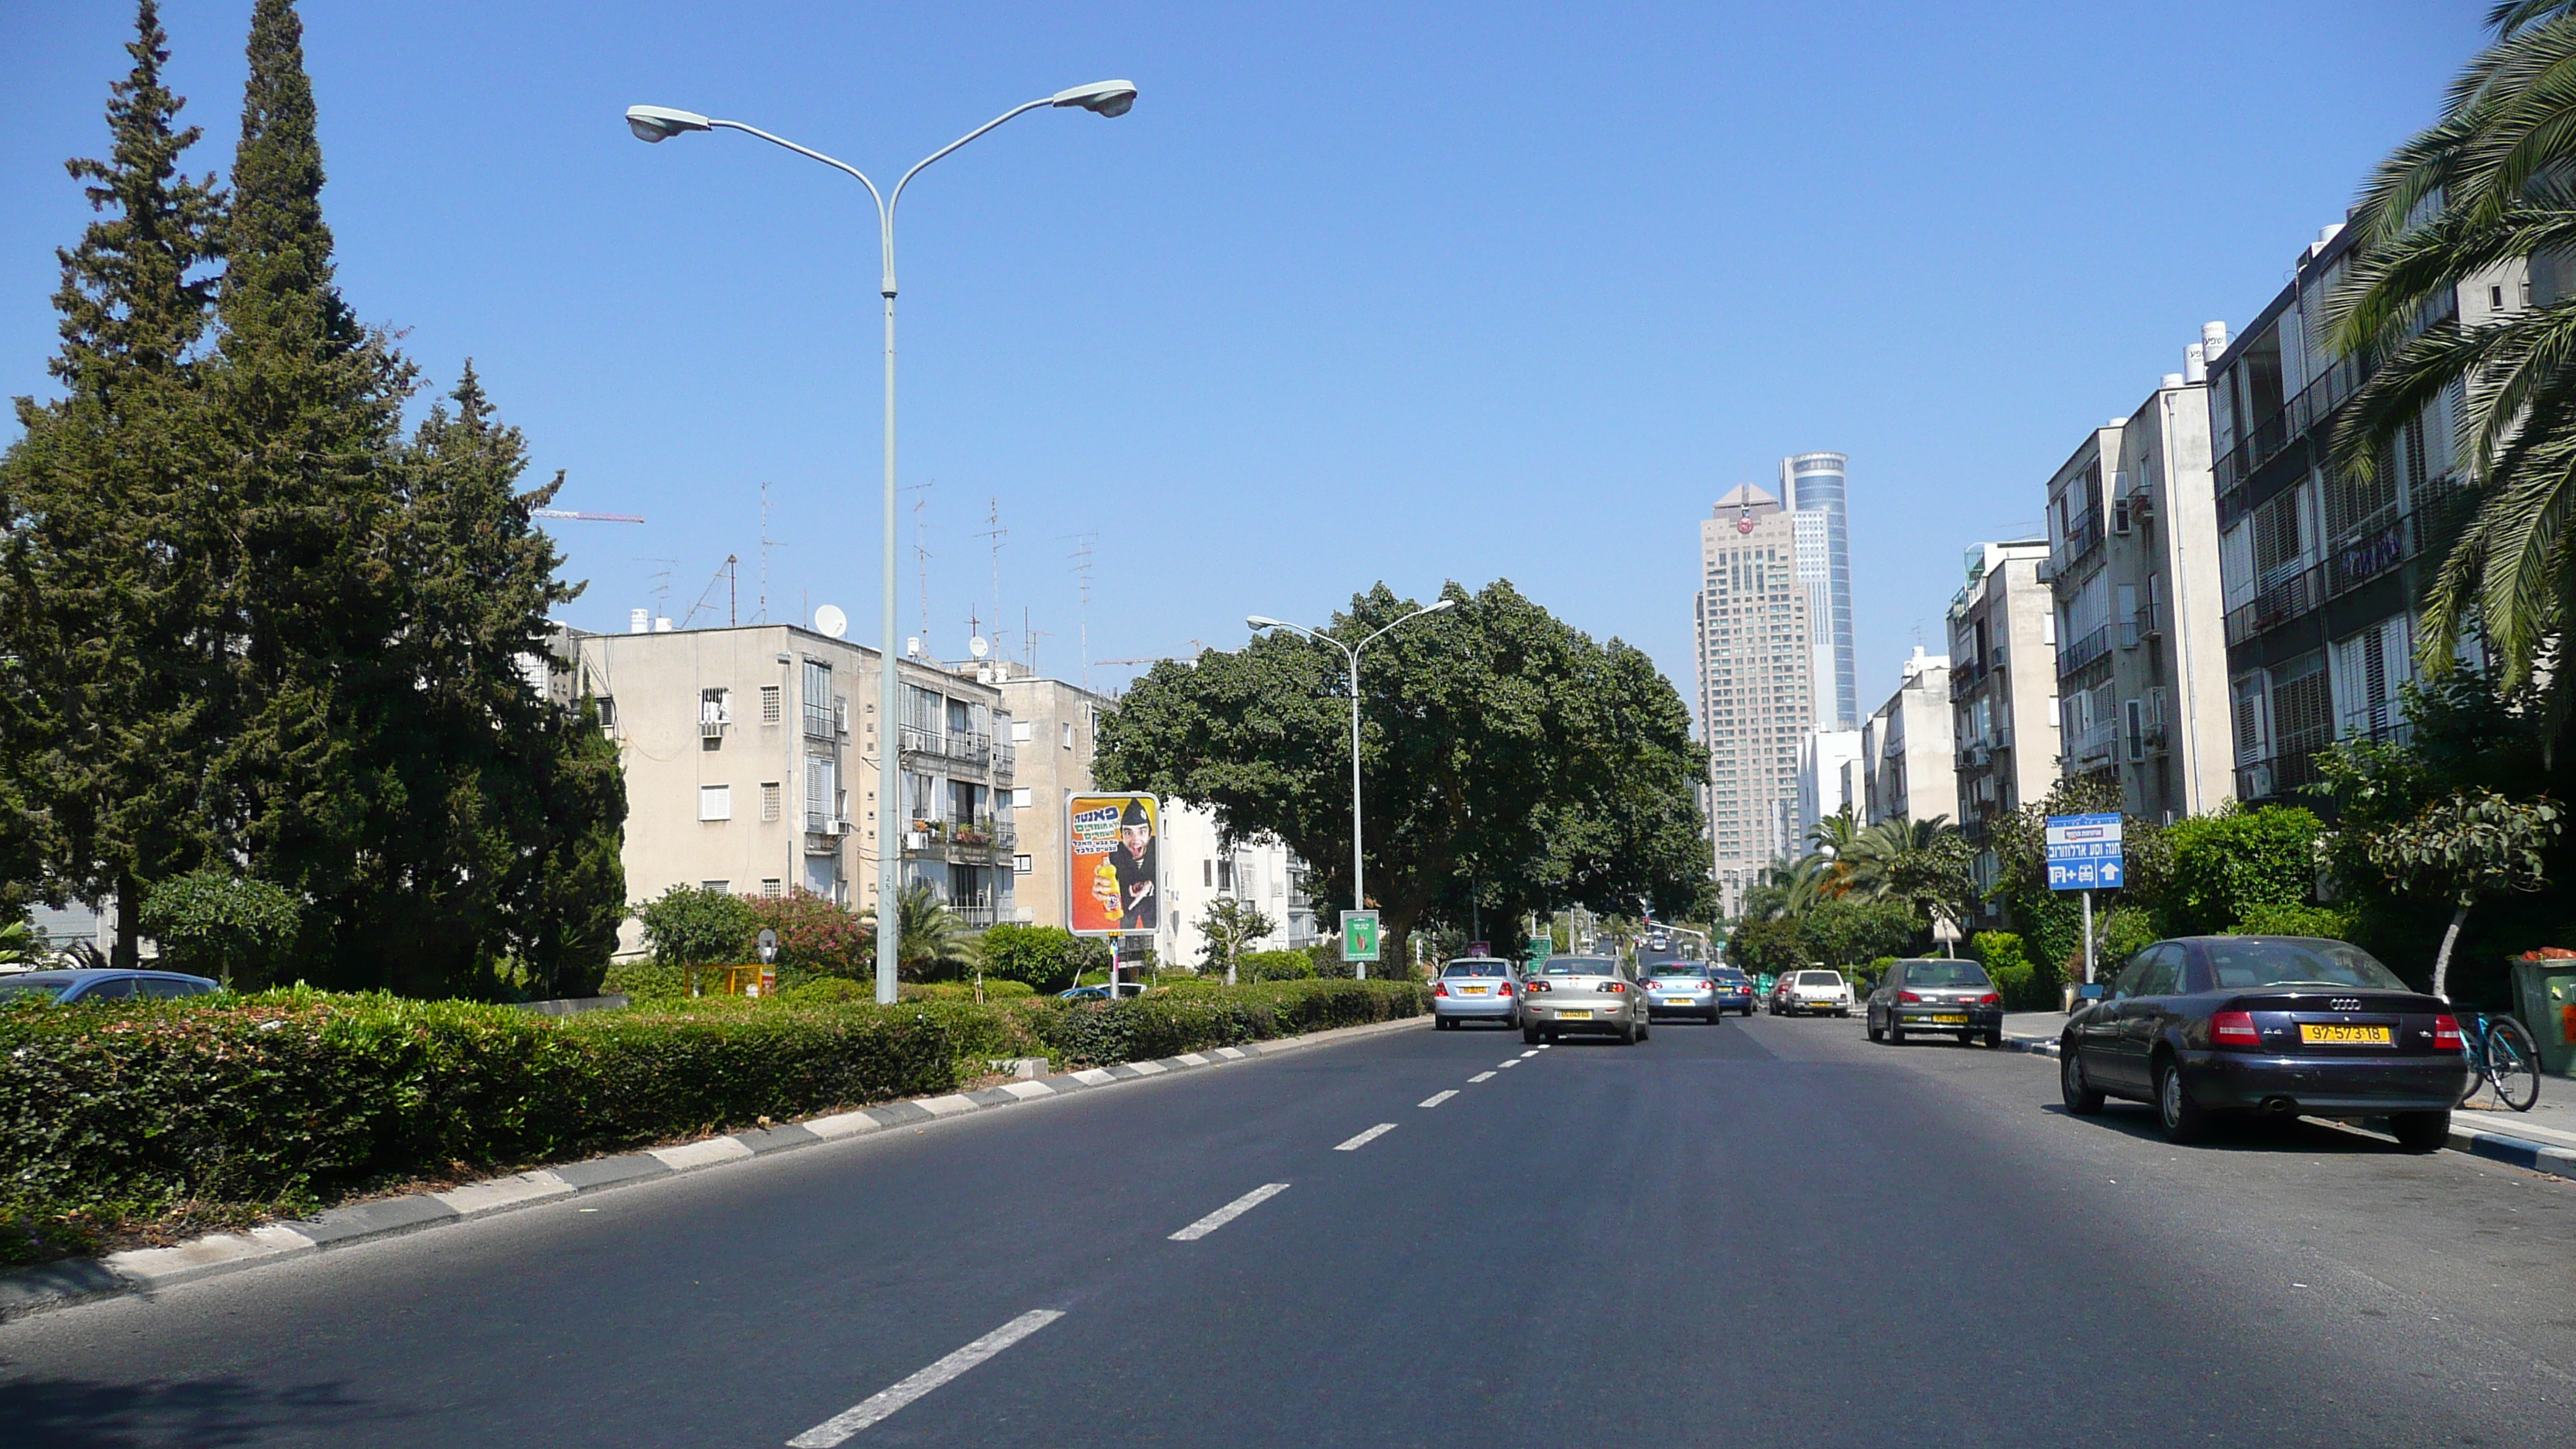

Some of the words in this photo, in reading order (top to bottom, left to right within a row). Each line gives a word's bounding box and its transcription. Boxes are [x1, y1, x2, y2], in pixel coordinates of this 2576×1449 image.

[1074, 807, 1118, 823] פאנטה
[1074, 823, 1108, 832] חומרים
[1084, 831, 1115, 839] משמרים
[2048, 844, 2086, 858] ארלוזורוב
[2090, 844, 2103, 855] וסע
[2105, 843, 2120, 855] חנה
